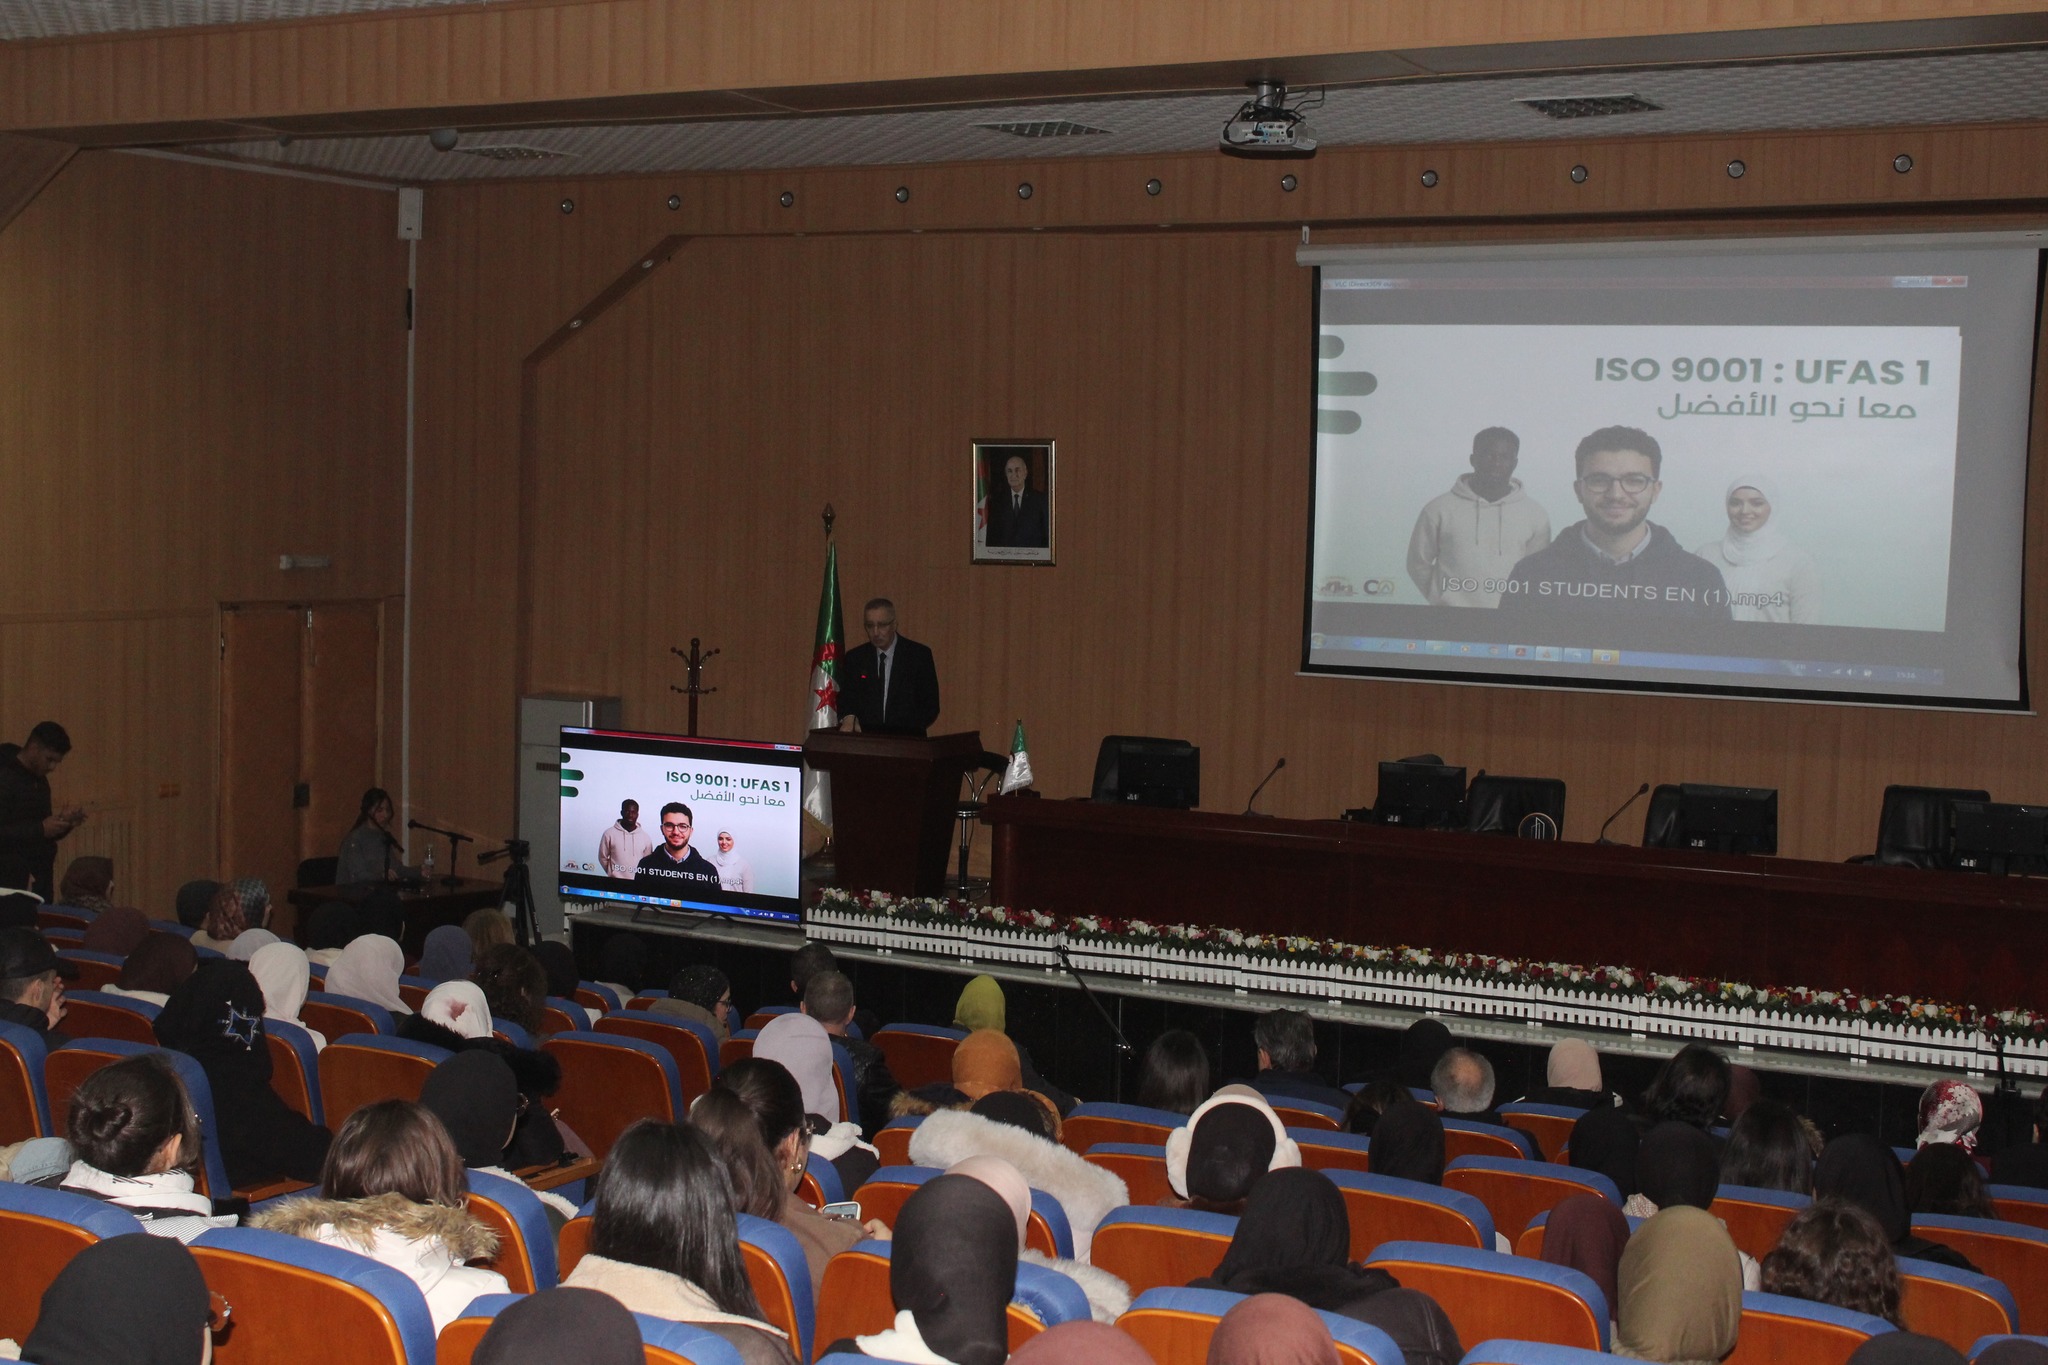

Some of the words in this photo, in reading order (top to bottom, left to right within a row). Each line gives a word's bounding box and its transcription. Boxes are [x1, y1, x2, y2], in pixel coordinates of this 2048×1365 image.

[1595, 357, 1660, 382] ISO
[1671, 357, 1763, 384] 9001
[1774, 362, 1784, 384] :
[1795, 359, 1905, 386] UFAS
[1916, 360, 1930, 386] 1
[1657, 391, 1777, 420] الأفضل
[1789, 397, 1845, 424] نحو
[1858, 396, 1917, 420] معا
[1441, 577, 1478, 593] ISO
[1484, 578, 1530, 595] 9001
[1538, 581, 1658, 601] STUDENTS
[1665, 586, 1696, 602] EN
[1703, 588, 1784, 608] (1).mp4
[666, 771, 691, 784] ISO
[695, 773, 729, 787] 9001
[740, 777, 781, 792] UFAS
[784, 781, 790, 793] 1
[690, 789, 735, 802] الأفضل
[738, 795, 760, 806] نحو
[764, 795, 786, 807] معا
[611, 864, 626, 873] ISO
[627, 866, 647, 875] 9001
[648, 868, 695, 880] STUDENTS
[696, 872, 708, 882] EN
